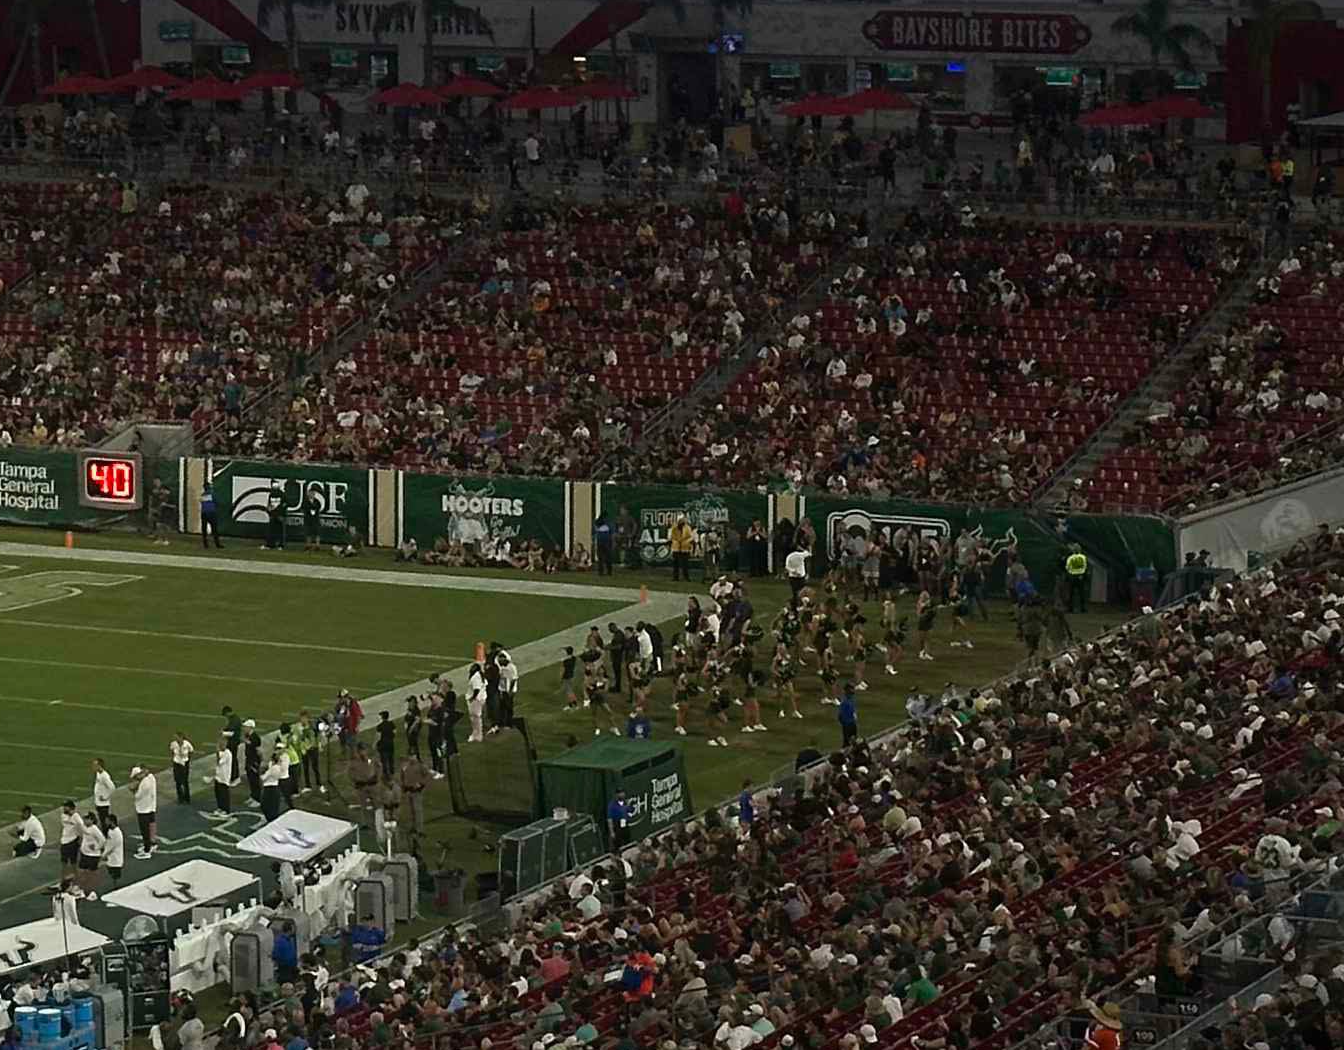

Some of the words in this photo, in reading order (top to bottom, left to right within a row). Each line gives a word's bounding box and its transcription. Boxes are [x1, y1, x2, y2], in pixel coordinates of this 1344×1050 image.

[891, 17, 993, 49] BAYSHORE
[1000, 18, 1062, 49] BITES
[91, 463, 132, 498] 40
[441, 493, 524, 518] HOOTERS
